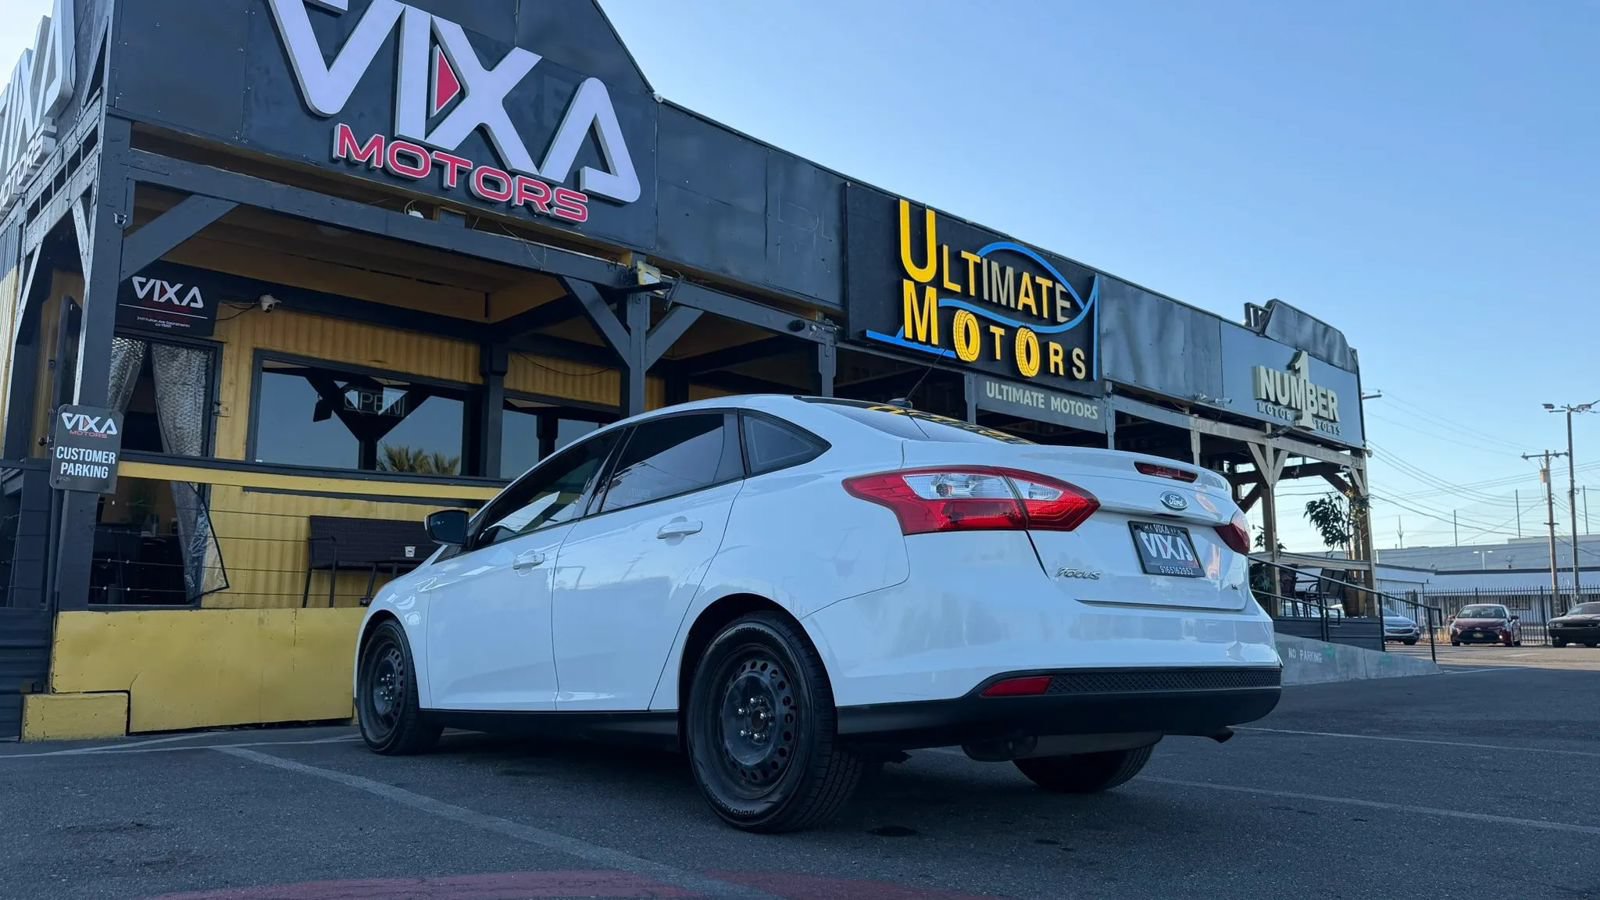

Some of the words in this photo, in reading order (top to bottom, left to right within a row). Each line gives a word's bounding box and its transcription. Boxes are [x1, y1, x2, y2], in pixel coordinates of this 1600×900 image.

[267, 0, 642, 203] VIXA
[334, 122, 590, 224] MOTORS
[900, 199, 1072, 323] ULTIMATE
[132, 276, 204, 309] VIXA
[903, 279, 1086, 380] MOTORS
[986, 381, 1045, 409] ULTIMATE
[1050, 396, 1098, 420] MOTORS
[1254, 365, 1341, 423] NUMBER
[61, 412, 118, 435] VIXA
[69, 430, 108, 439] MOTORS
[56, 446, 116, 465] CUSTOMER
[60, 462, 109, 479] PARKING
[1140, 532, 1194, 562] VIXA
[1288, 647, 1297, 659] NO
[1300, 649, 1323, 664] PARKING
